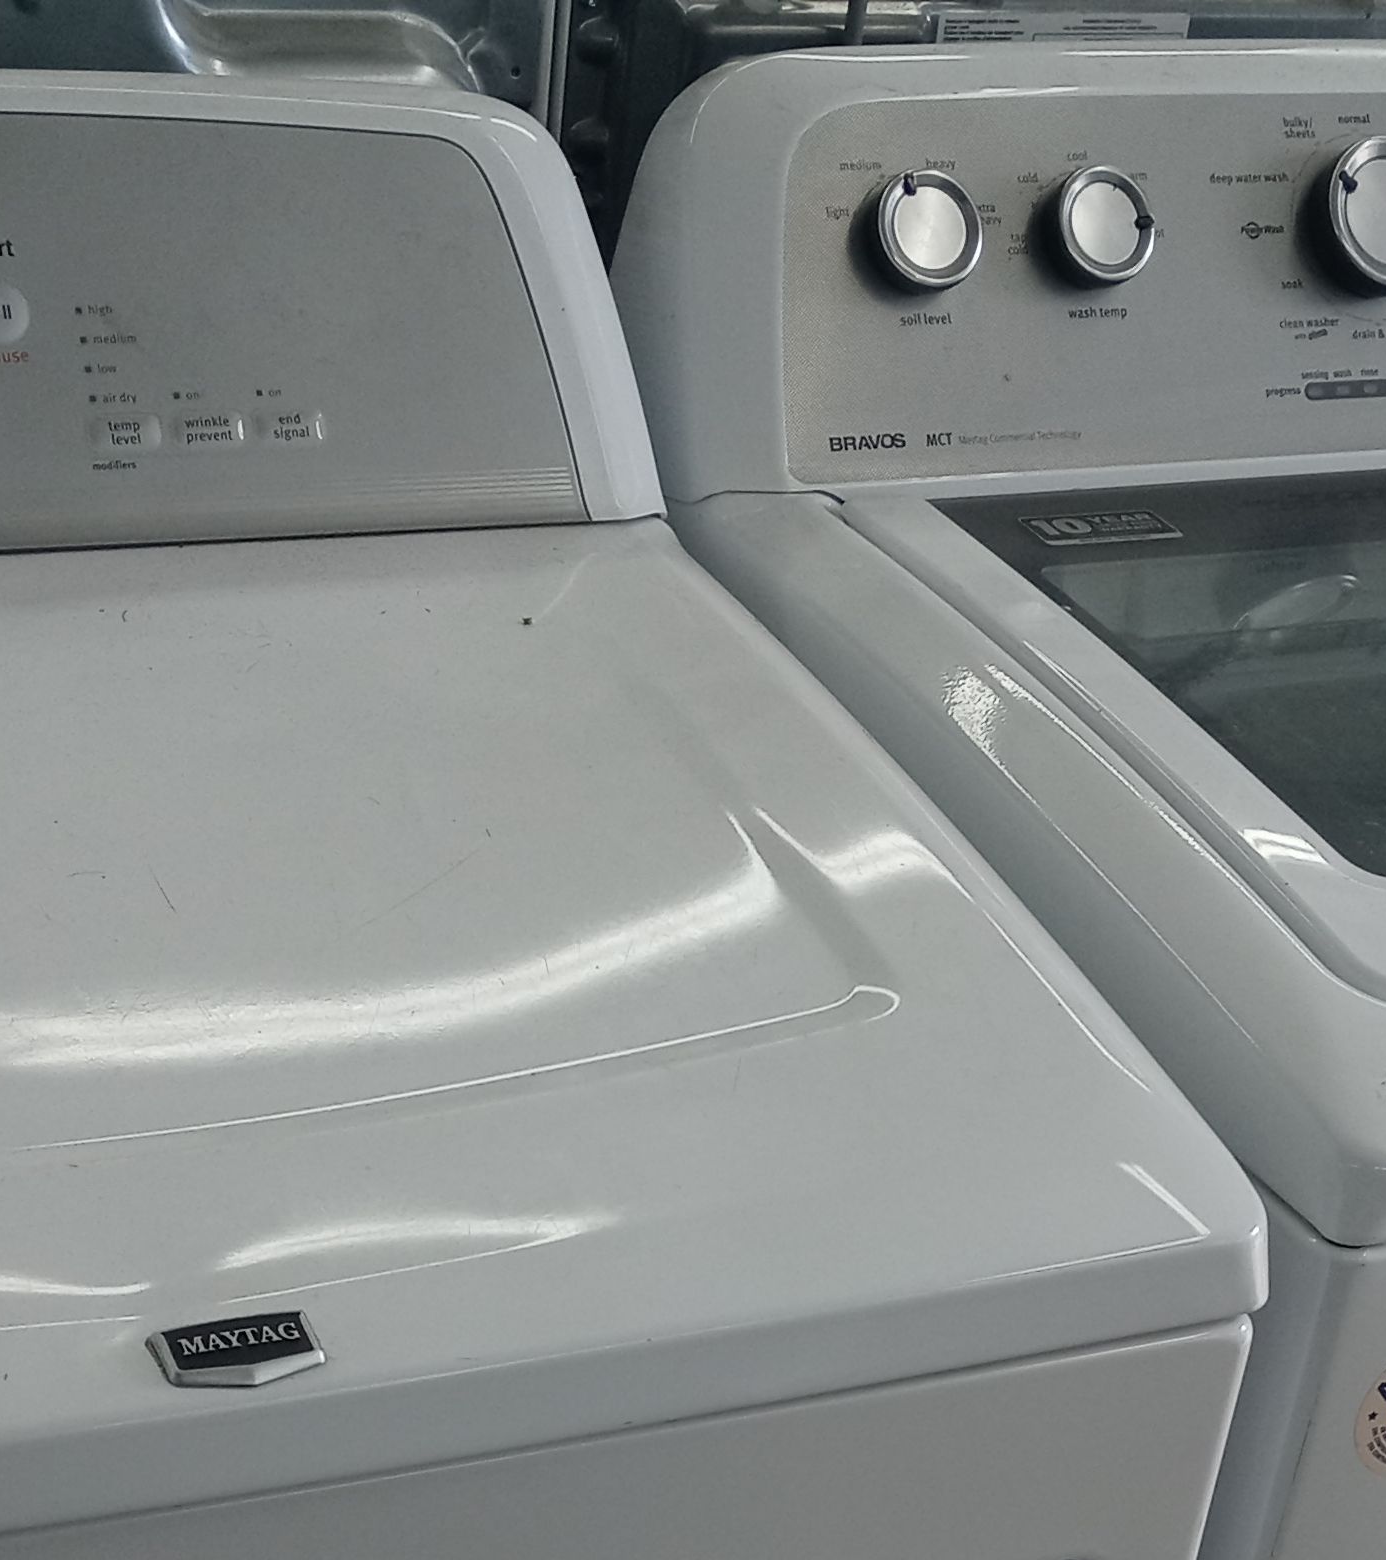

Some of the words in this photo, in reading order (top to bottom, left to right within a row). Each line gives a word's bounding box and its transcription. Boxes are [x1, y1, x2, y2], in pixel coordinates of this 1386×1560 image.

[1338, 114, 1371, 124] normal
[925, 157, 956, 171] heavy
[1209, 173, 1233, 186] deep
[1235, 173, 1262, 183] water
[1264, 172, 1289, 183] wash
[1281, 278, 1303, 290] soak
[87, 304, 113, 317] high
[1068, 306, 1097, 319] wash
[1100, 305, 1128, 320] temp
[899, 314, 922, 327] soil
[924, 312, 952, 326] level
[1279, 319, 1305, 330] clean
[1306, 316, 1339, 328] washer
[93, 332, 137, 344] medium
[1352, 328, 1376, 340] drain
[1378, 328, 1386, 339] &
[97, 363, 117, 374] low
[102, 392, 118, 404] air
[120, 392, 137, 405] dry
[185, 391, 200, 400] on
[268, 388, 282, 398] on
[1265, 385, 1302, 399] progress
[184, 415, 230, 428] wrinkle
[278, 413, 301, 425] end
[107, 420, 141, 433] temp
[273, 425, 310, 440] signal
[111, 432, 142, 446] level
[186, 428, 233, 445] prevent
[829, 432, 906, 453] BRAVOS
[926, 431, 953, 448] MCT
[92, 460, 137, 471] modifiers
[1029, 517, 1094, 536] 10
[177, 1321, 302, 1356] MAYTAG
